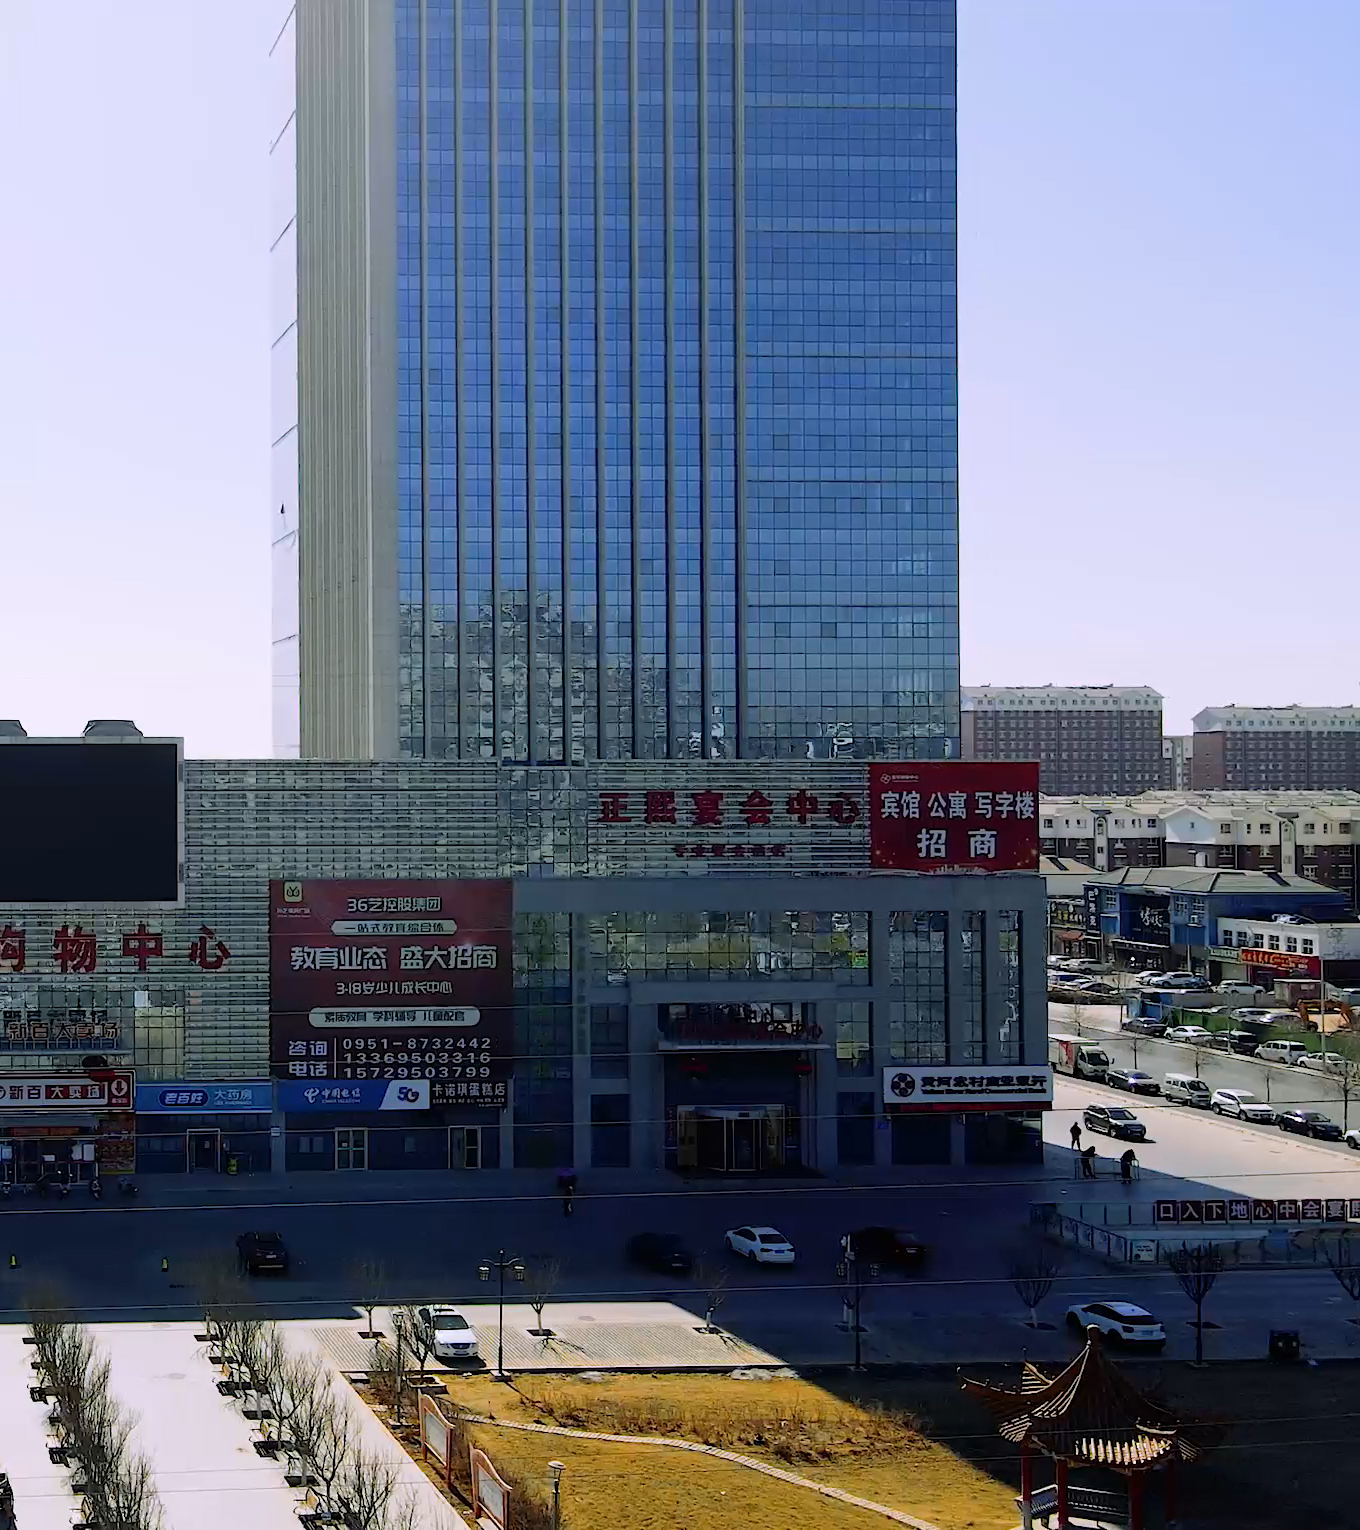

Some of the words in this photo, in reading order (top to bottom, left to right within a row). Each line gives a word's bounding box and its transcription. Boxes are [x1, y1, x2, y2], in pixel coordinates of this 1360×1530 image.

[597, 789, 862, 826] 正熙宴会中心
[880, 789, 921, 820] 宾馆
[927, 789, 968, 820] 公寓
[974, 789, 1035, 820] 写字楼
[916, 828, 998, 859] 招商
[290, 945, 388, 971] 教育业态
[399, 945, 498, 971] 盛大招商
[8, 1021, 119, 1040] 新百大卖场
[288, 1040, 328, 1057] 咨询
[342, 1037, 492, 1050] 0951-8732442
[343, 1052, 491, 1064] 13369503316
[288, 1060, 328, 1077] 电话
[343, 1066, 491, 1079] 15729503799
[213, 1088, 253, 1100] 大药房
[321, 1086, 362, 1099] 中国电信
[396, 1086, 420, 1103] 5G
